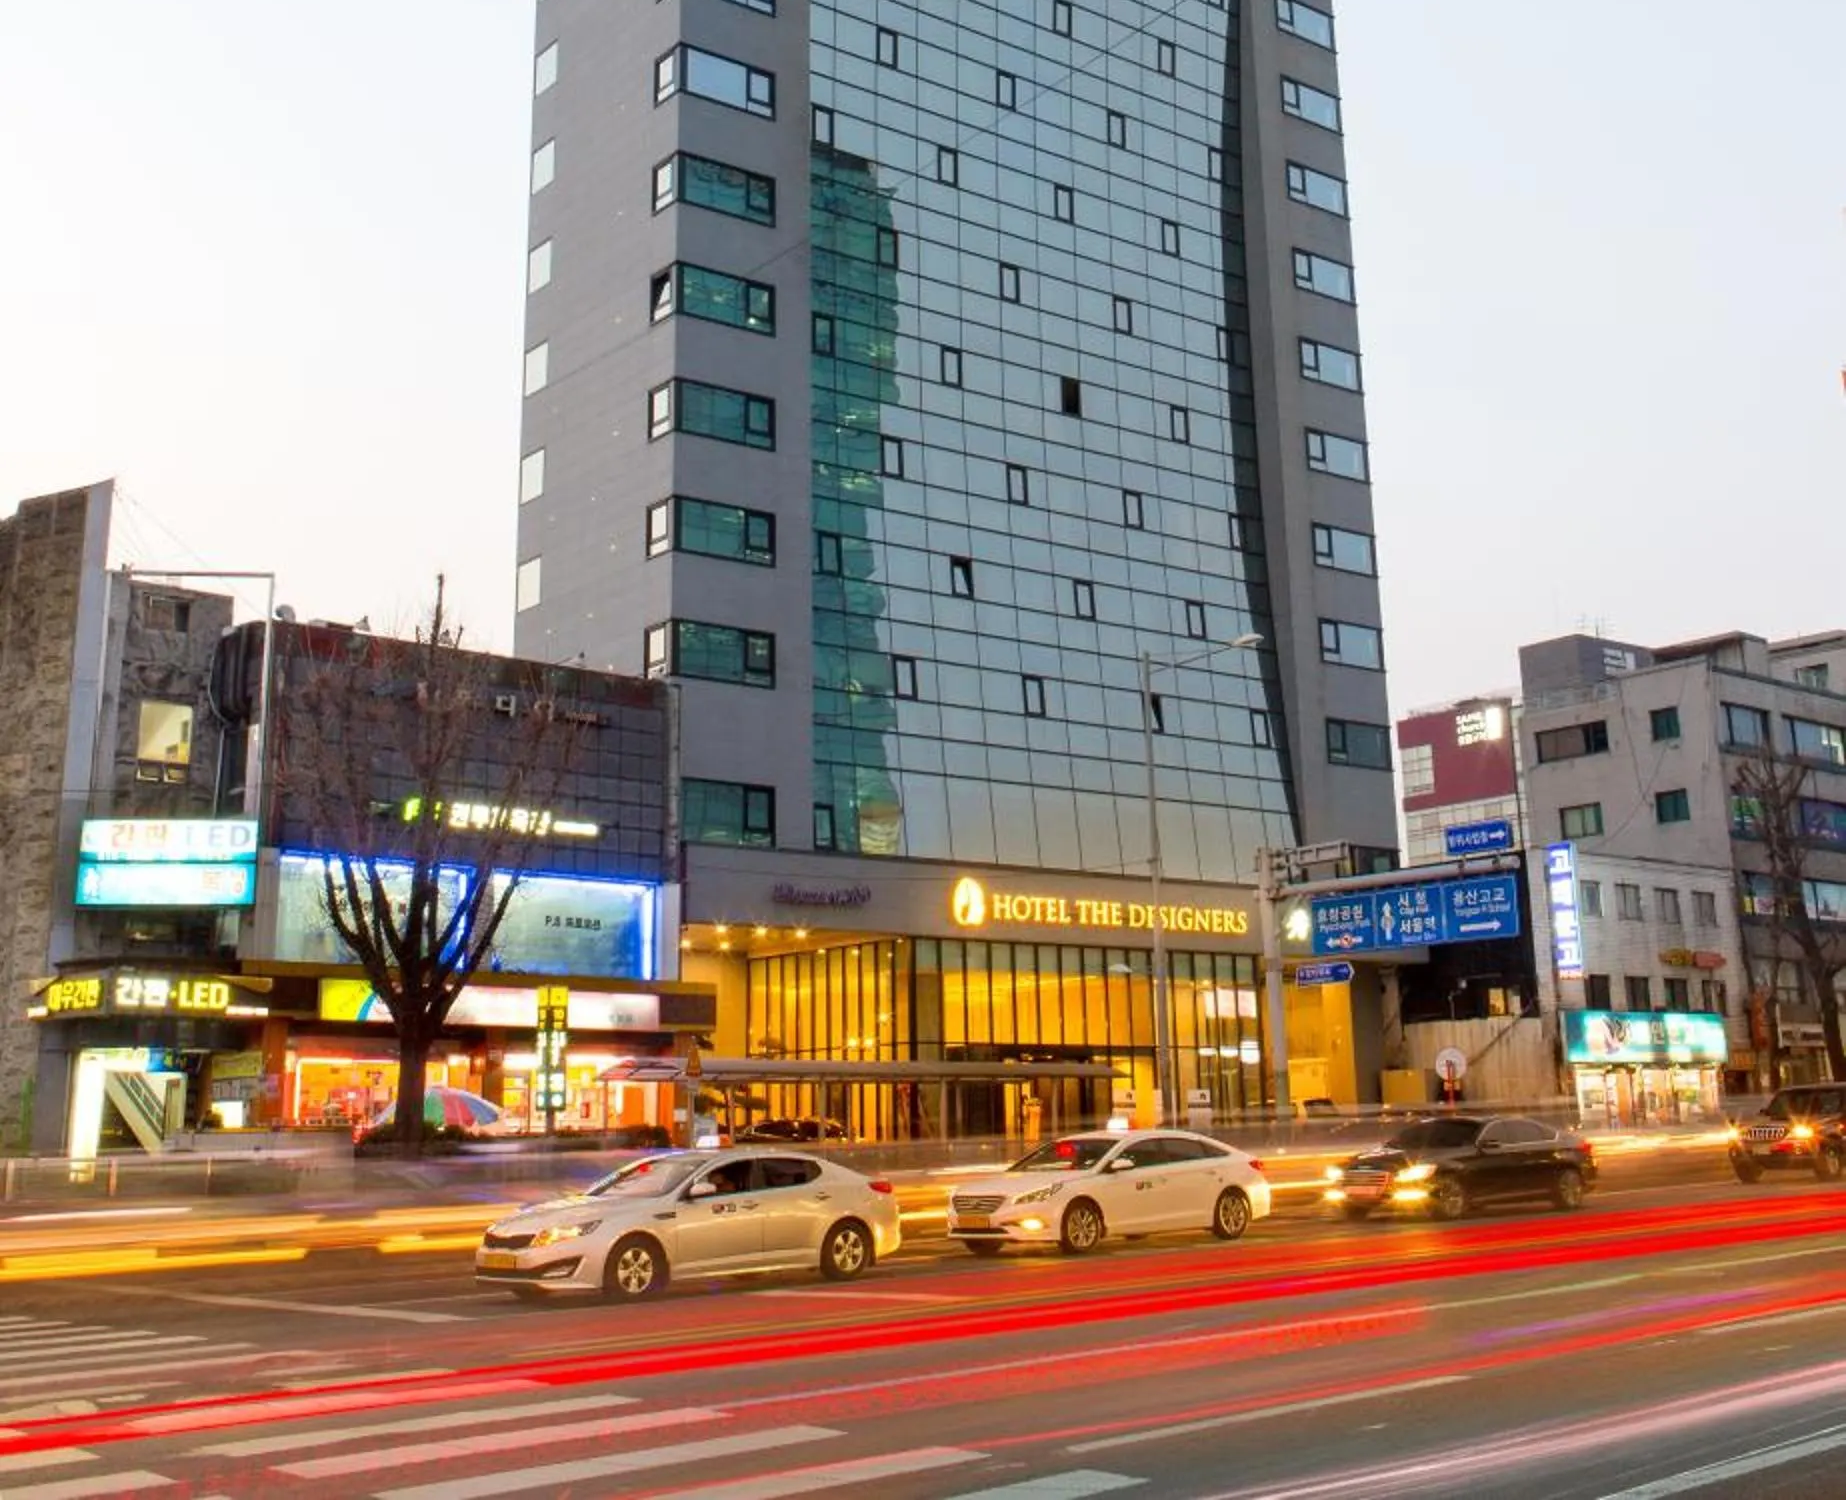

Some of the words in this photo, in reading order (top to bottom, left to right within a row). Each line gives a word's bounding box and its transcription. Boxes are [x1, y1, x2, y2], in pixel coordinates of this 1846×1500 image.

[993, 893, 1070, 924] HOTEL
[1075, 899, 1122, 927] THE
[1399, 915, 1436, 934] 서울역
